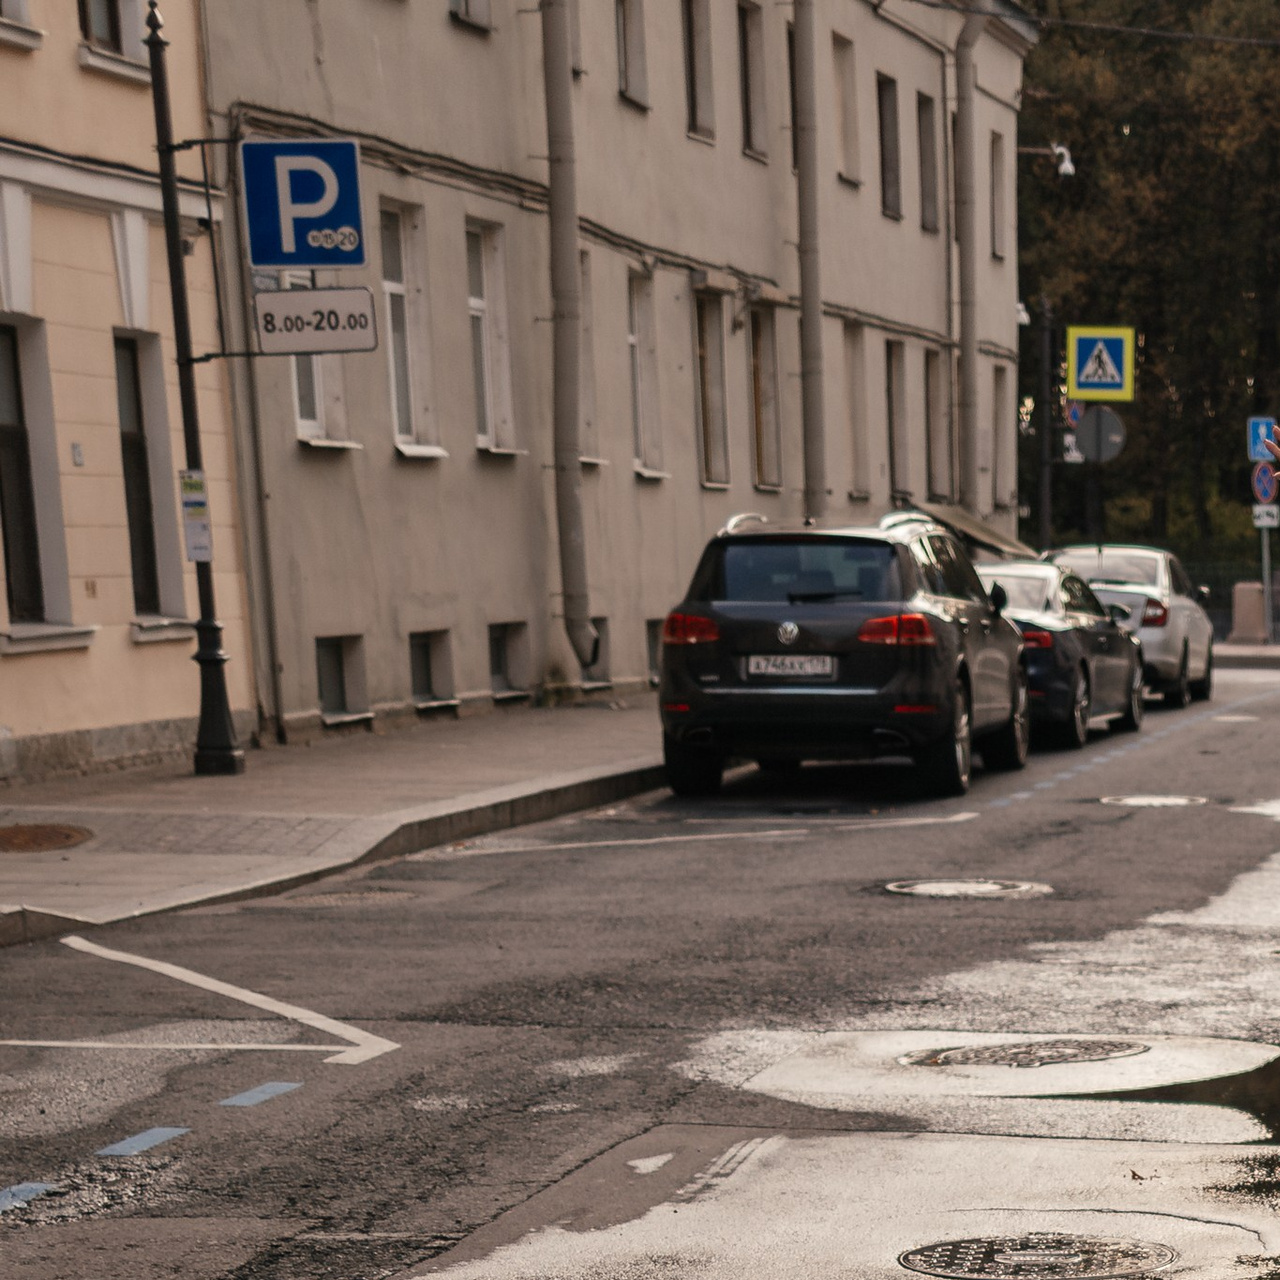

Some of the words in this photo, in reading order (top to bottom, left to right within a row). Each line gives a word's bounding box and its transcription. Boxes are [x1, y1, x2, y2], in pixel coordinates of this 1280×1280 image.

[274, 155, 340, 253] P
[339, 231, 357, 246] 20
[263, 309, 369, 333] 8.00-20.00
